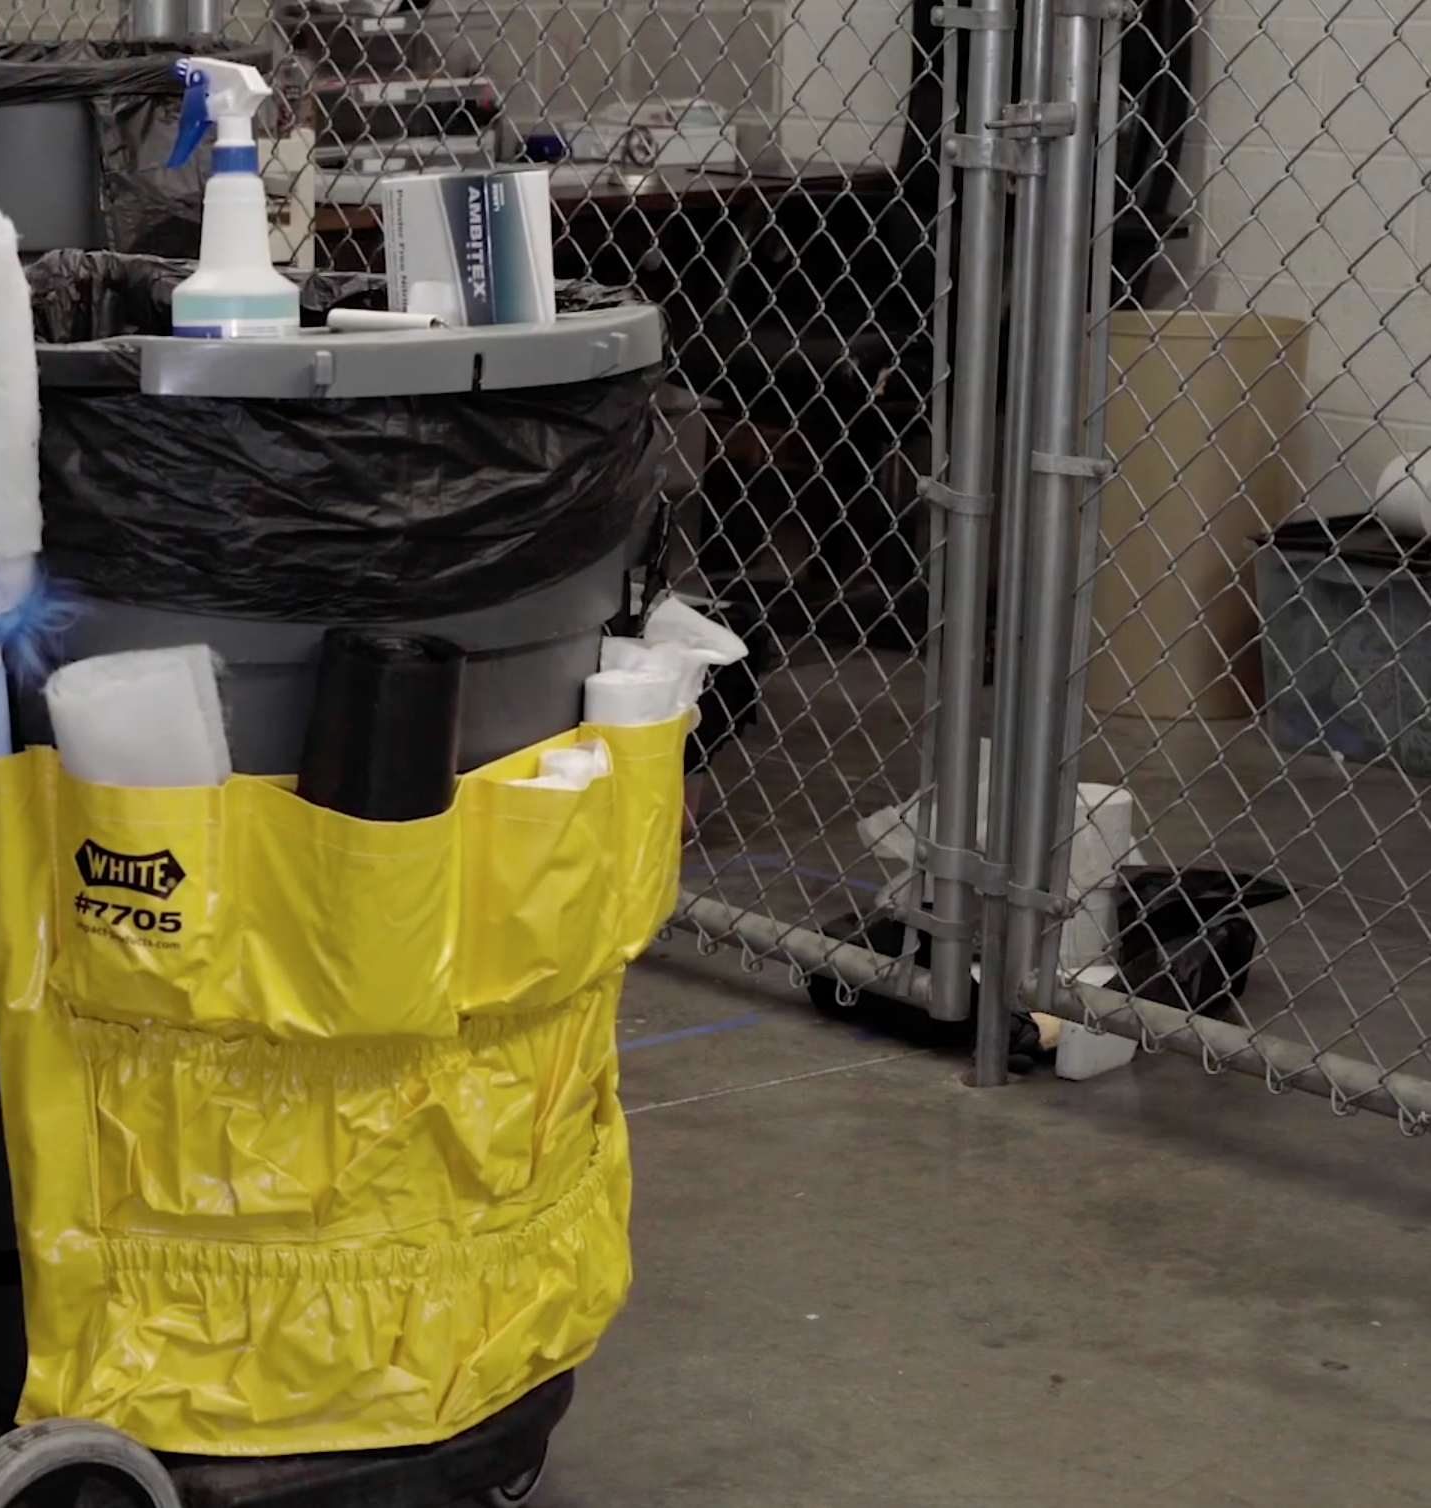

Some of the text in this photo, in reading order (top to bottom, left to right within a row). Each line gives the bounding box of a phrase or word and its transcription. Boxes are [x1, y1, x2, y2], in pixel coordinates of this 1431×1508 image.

[467, 185, 487, 298] AMBITEX
[84, 844, 170, 894] WHITE
[74, 891, 182, 933] #7705
